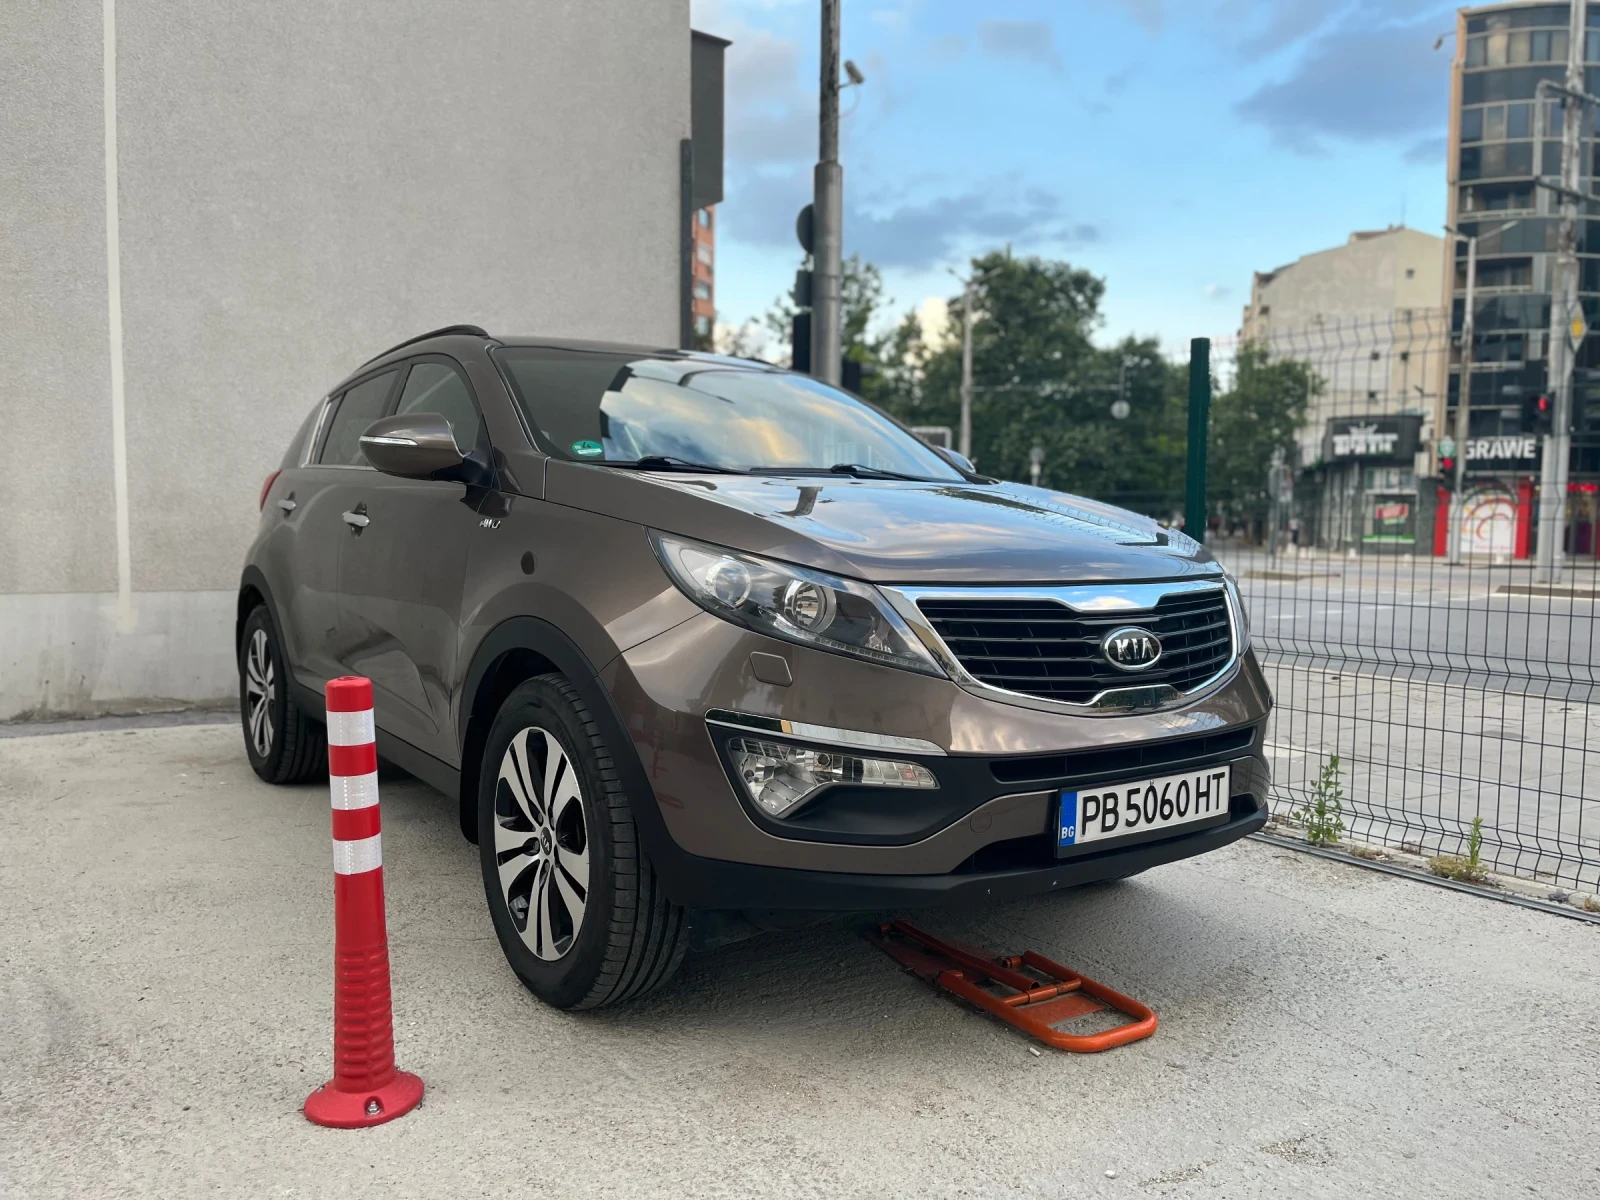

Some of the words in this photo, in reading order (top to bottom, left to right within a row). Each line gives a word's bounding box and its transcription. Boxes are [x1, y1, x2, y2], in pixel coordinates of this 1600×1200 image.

[1464, 439, 1536, 460] GRAWE
[1114, 638, 1155, 660] KIA
[1081, 792, 1119, 836] PB
[1125, 779, 1190, 828] 5060
[1195, 771, 1226, 815] HT
[1061, 825, 1075, 839] BG
